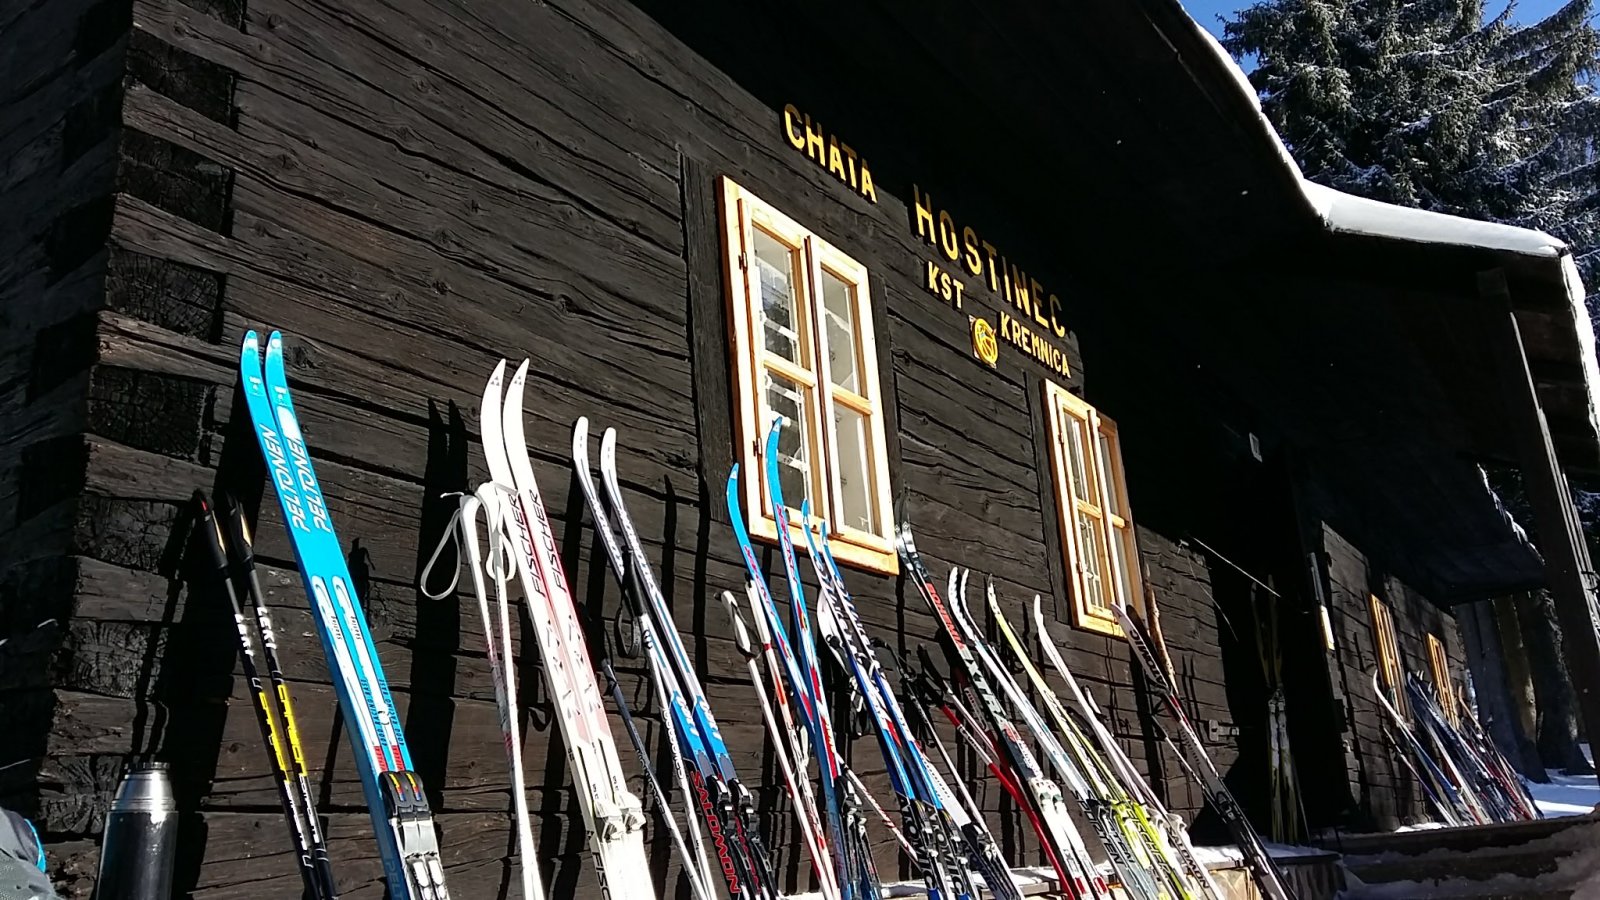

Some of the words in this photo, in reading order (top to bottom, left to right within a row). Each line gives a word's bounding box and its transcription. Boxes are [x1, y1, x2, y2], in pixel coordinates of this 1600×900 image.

[784, 103, 877, 203] CHATA
[913, 184, 1066, 339] HOSTINEC
[928, 261, 964, 309] KST
[1000, 310, 1071, 379] KREMNICA
[259, 424, 311, 533] PELTONEN
[508, 493, 546, 597] FISCHER
[529, 489, 567, 594] FISCHER
[234, 614, 254, 657] LEKI
[257, 607, 277, 650] LEKI
[924, 582, 965, 650] BOHEMIA
[1128, 629, 1166, 684] ATOMIC
[690, 769, 741, 894] SALOMON
[900, 801, 935, 890] ATOMIC
[926, 803, 967, 896] ATOMIC
[1070, 790, 1124, 864] SPORTEN
[1126, 808, 1172, 876] FISCHER
[1164, 825, 1210, 889] SALOMON
